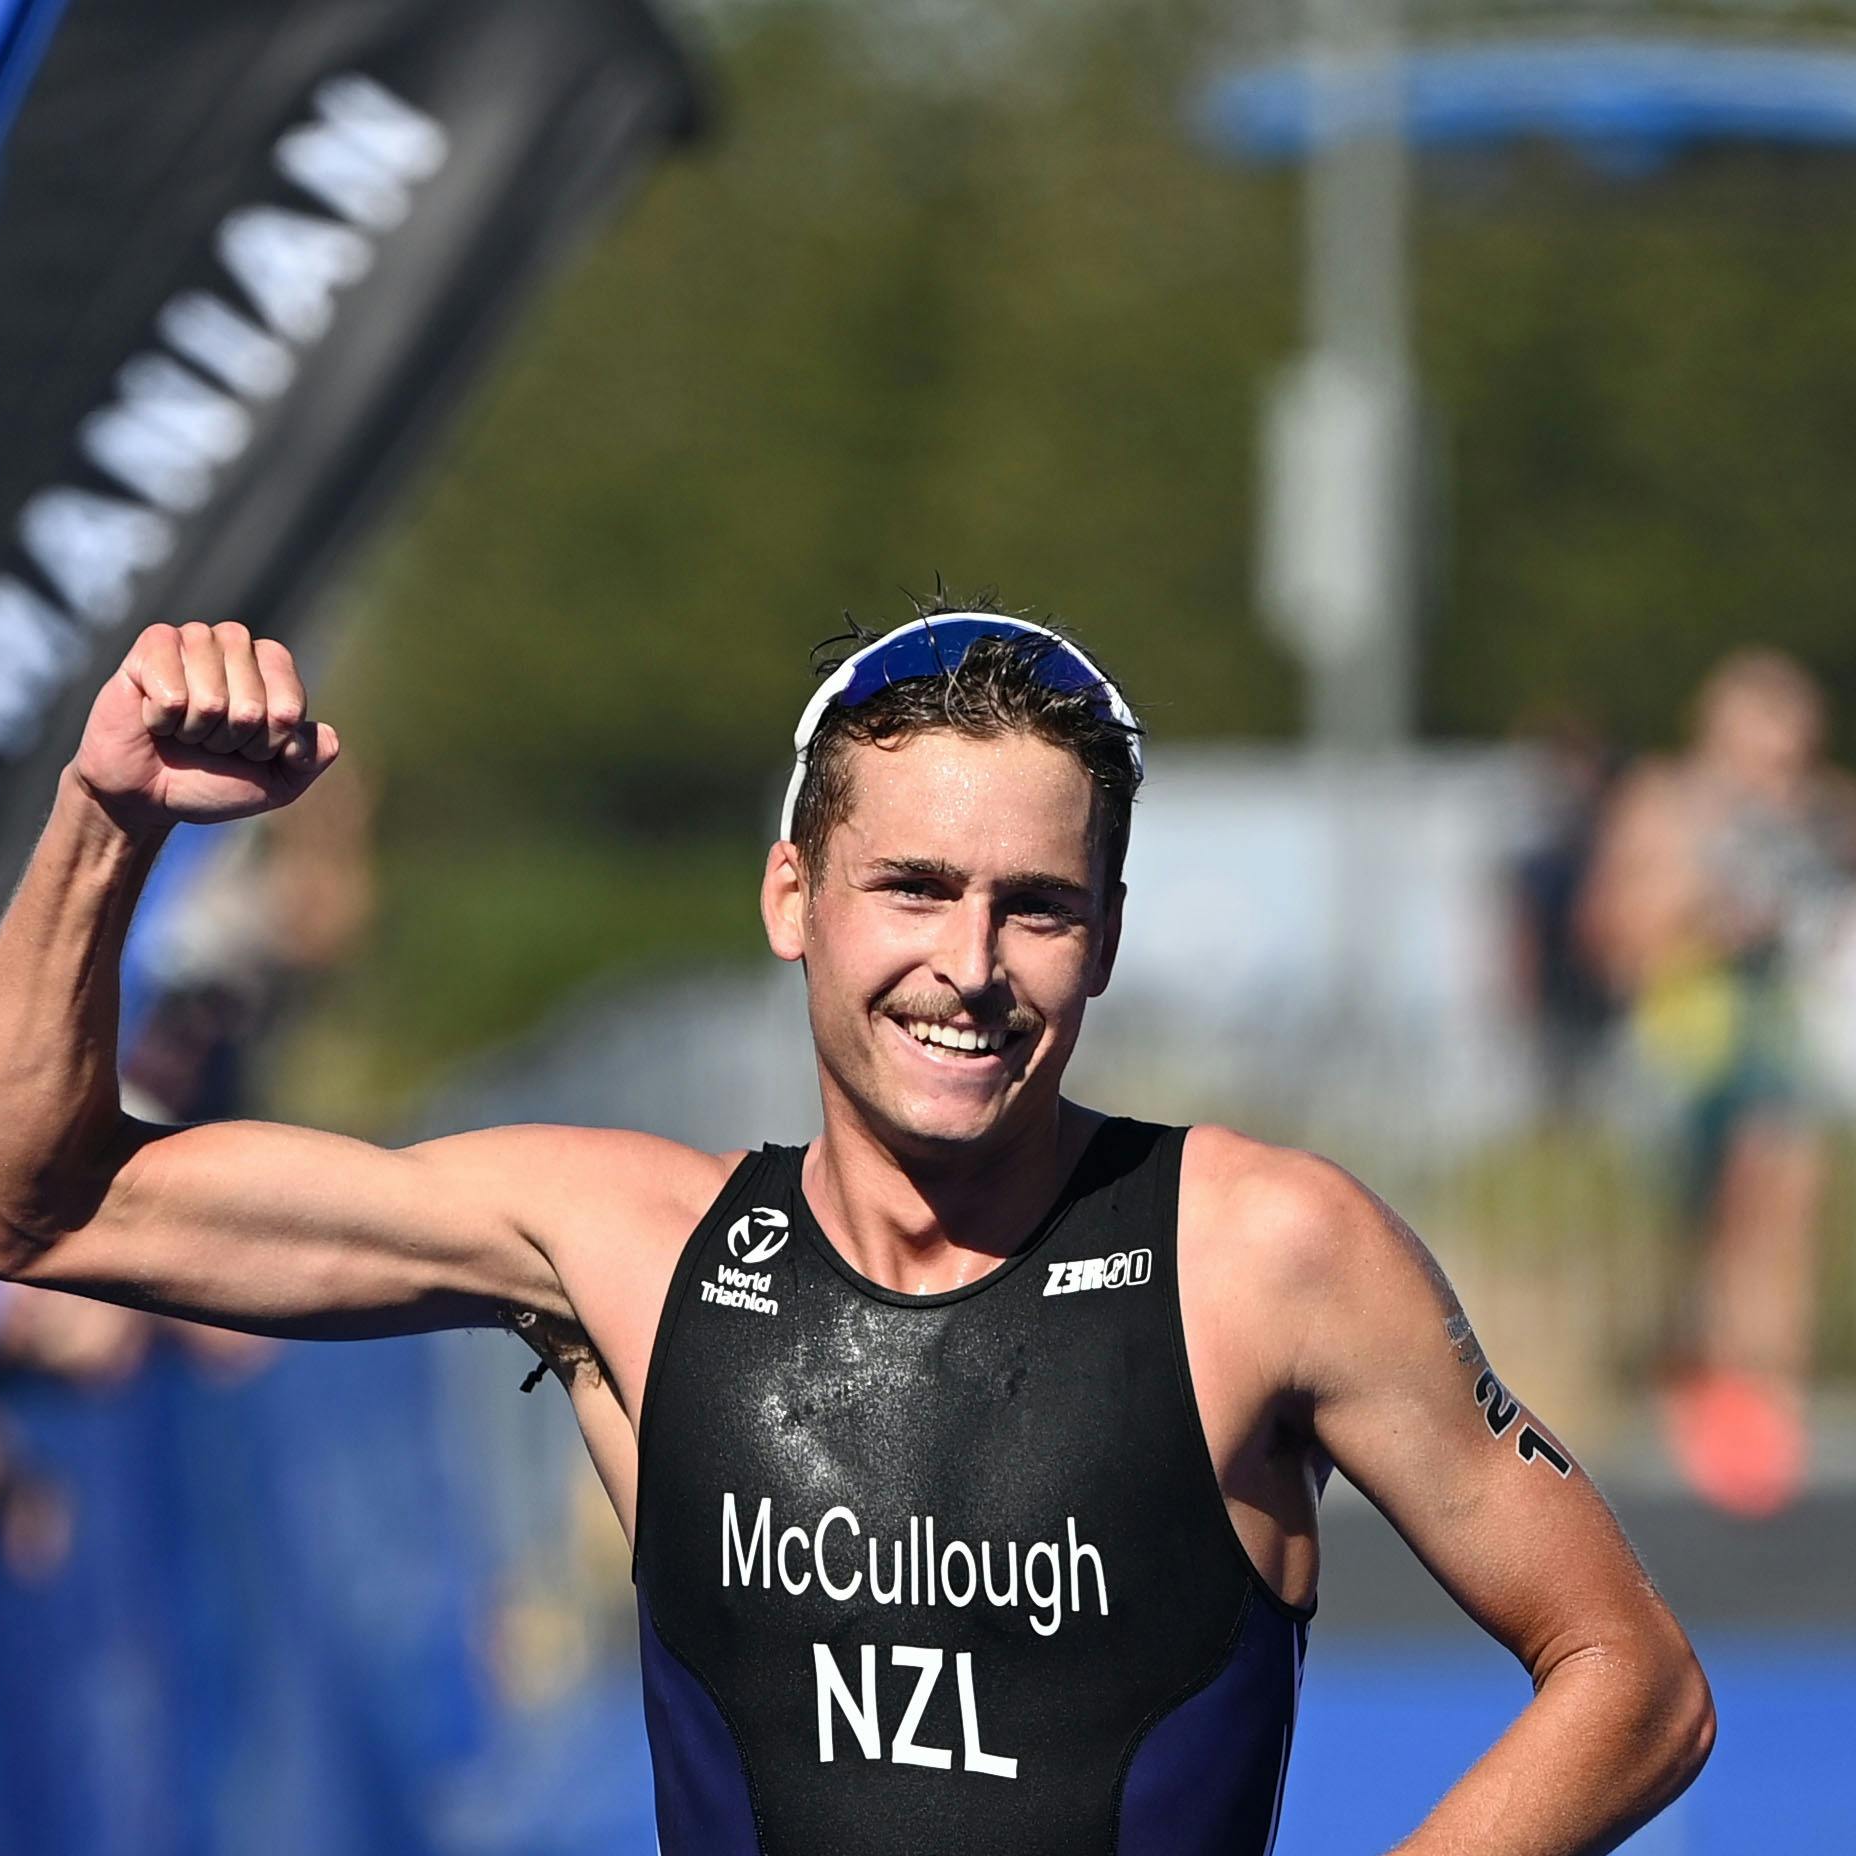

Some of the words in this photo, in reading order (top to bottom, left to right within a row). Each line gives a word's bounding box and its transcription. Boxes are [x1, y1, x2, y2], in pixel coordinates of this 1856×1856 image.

[700, 1280, 779, 1316] Triathlon
[717, 1264, 772, 1293] World
[1473, 1367, 1574, 1480] 21
[721, 1492, 1109, 1636] McCullough
[812, 1642, 1018, 1779] NZL
